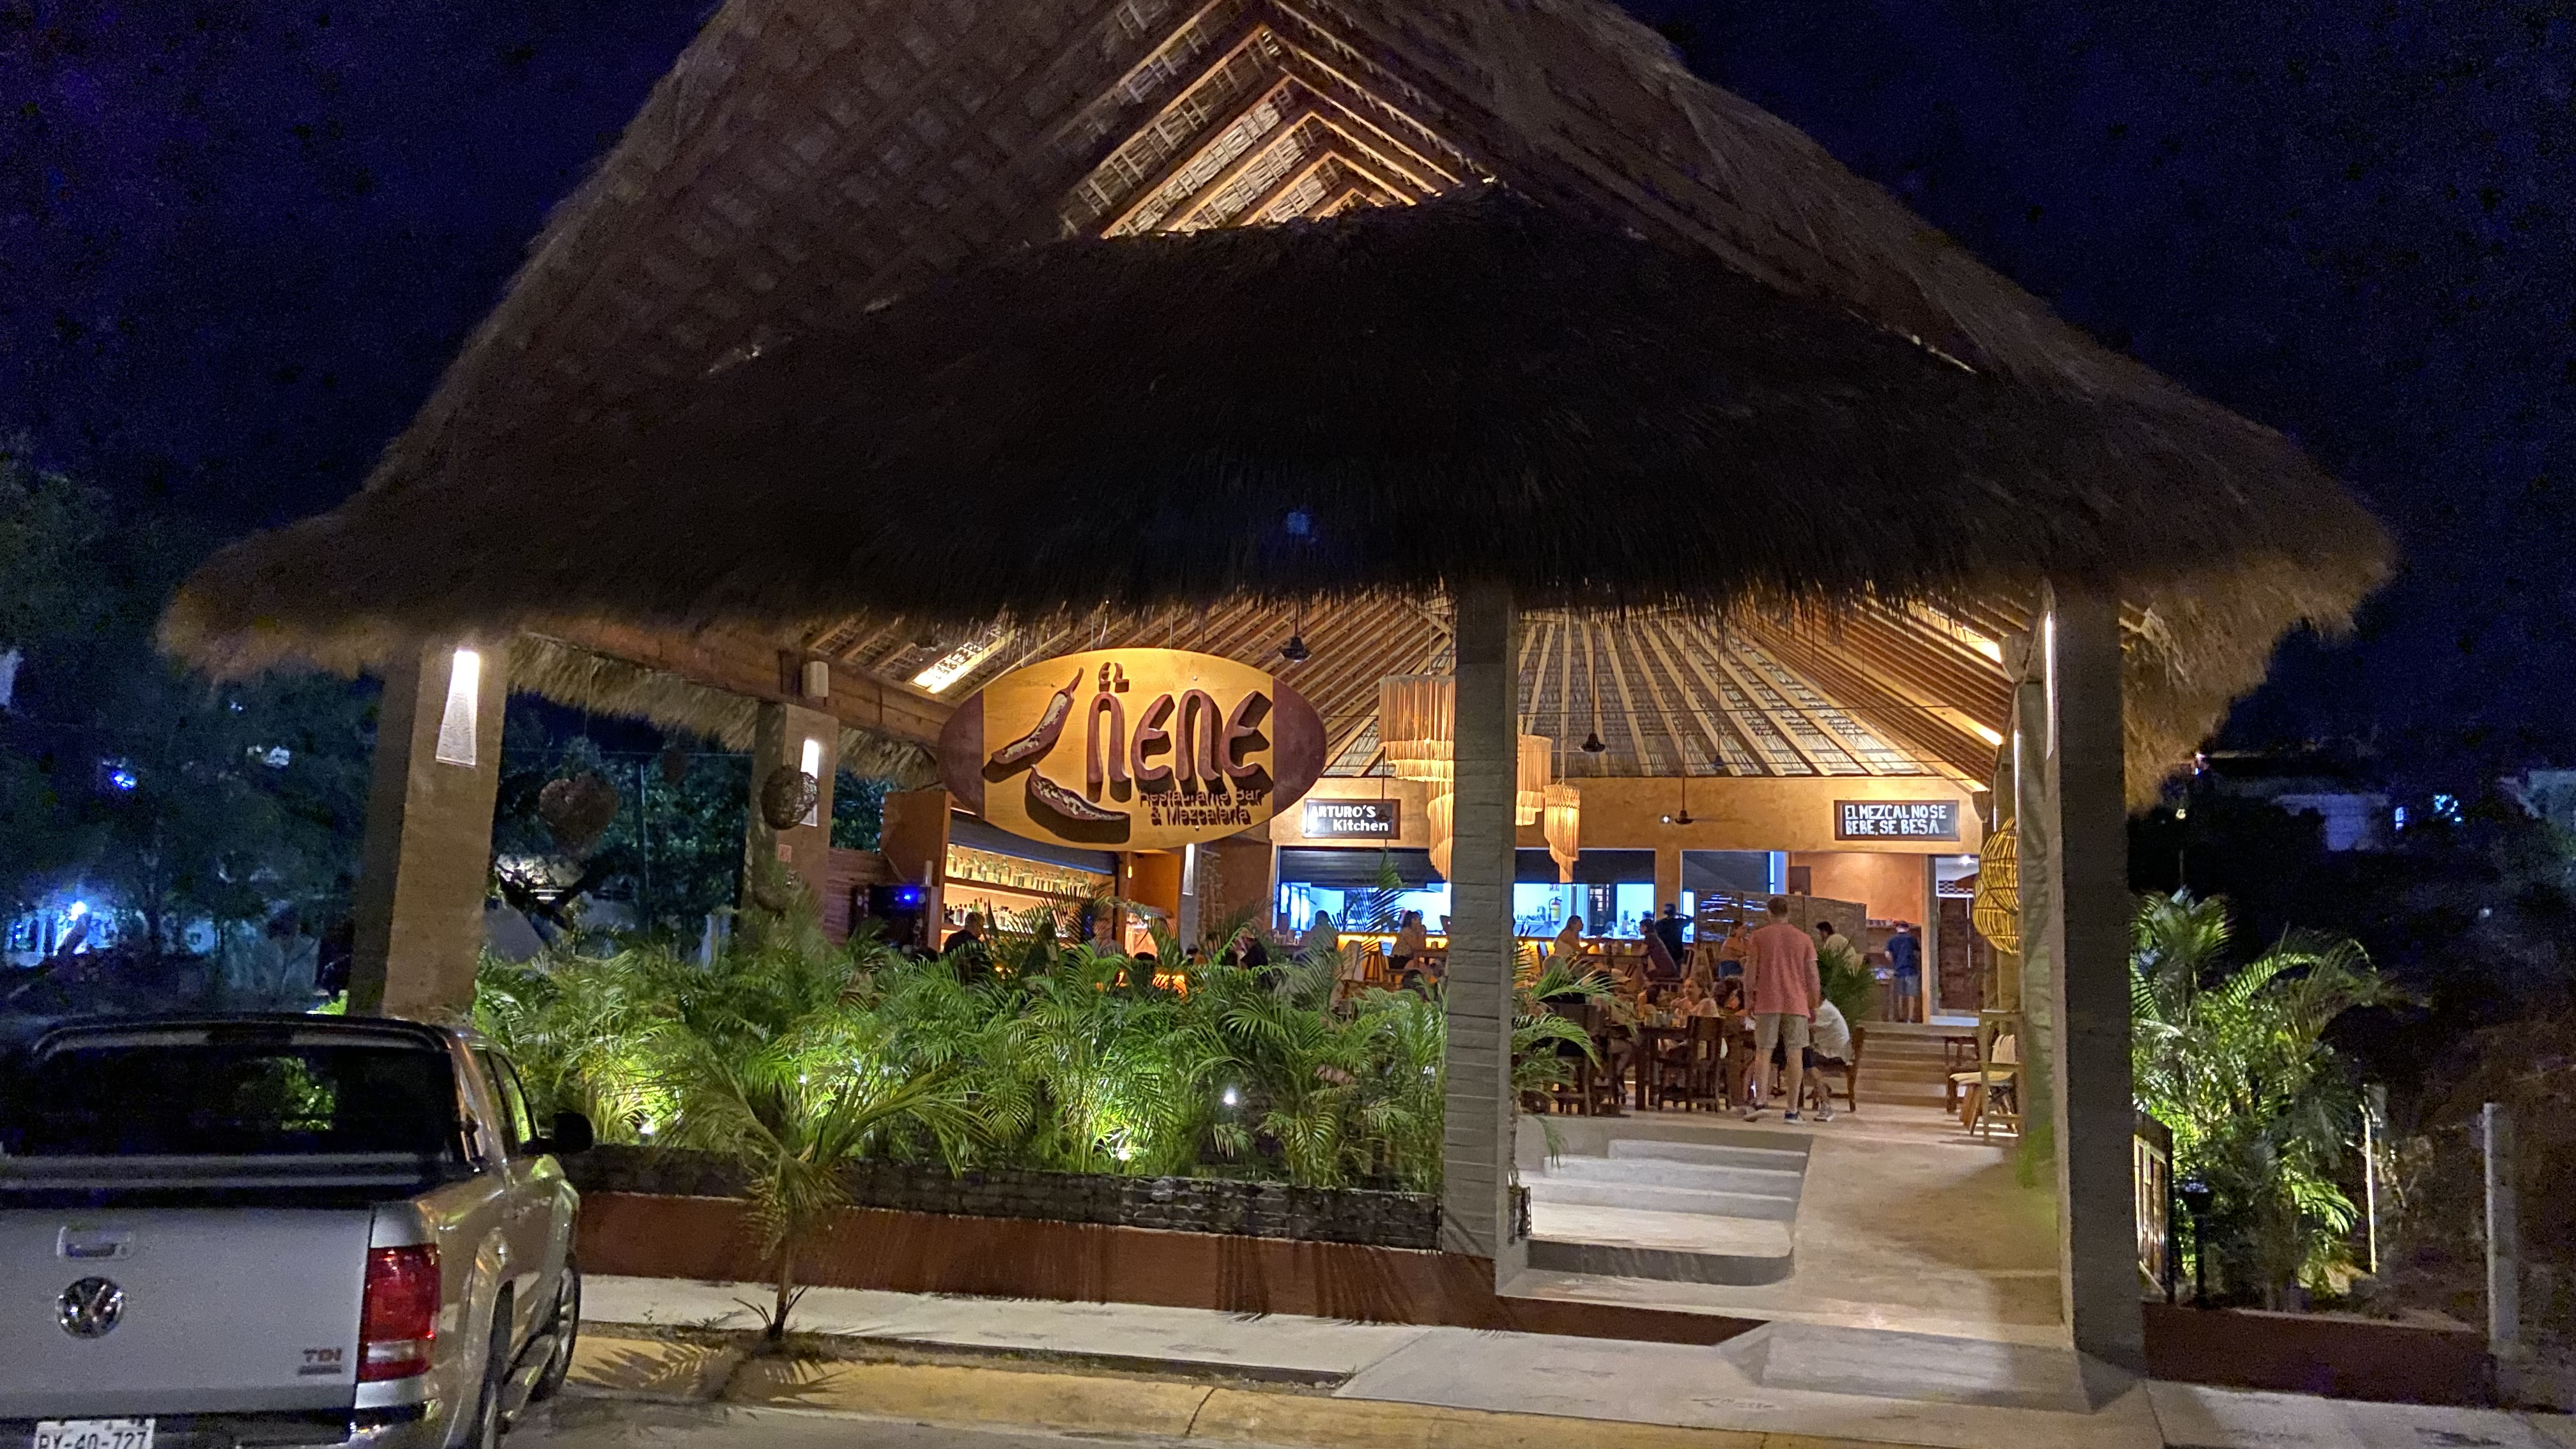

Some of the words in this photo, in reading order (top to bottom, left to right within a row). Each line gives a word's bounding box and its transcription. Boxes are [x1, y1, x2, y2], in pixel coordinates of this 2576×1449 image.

[1098, 662, 1130, 686] EL
[1236, 788, 1262, 805] Bar
[1151, 806, 1162, 825] &
[1310, 804, 1376, 818] ARTURO'S
[1859, 805, 1910, 820] MEZCAL
[1911, 805, 1929, 819] NO
[1929, 805, 1947, 819] SE
[1333, 819, 1389, 831] Kitchen
[1880, 820, 1897, 835] SE
